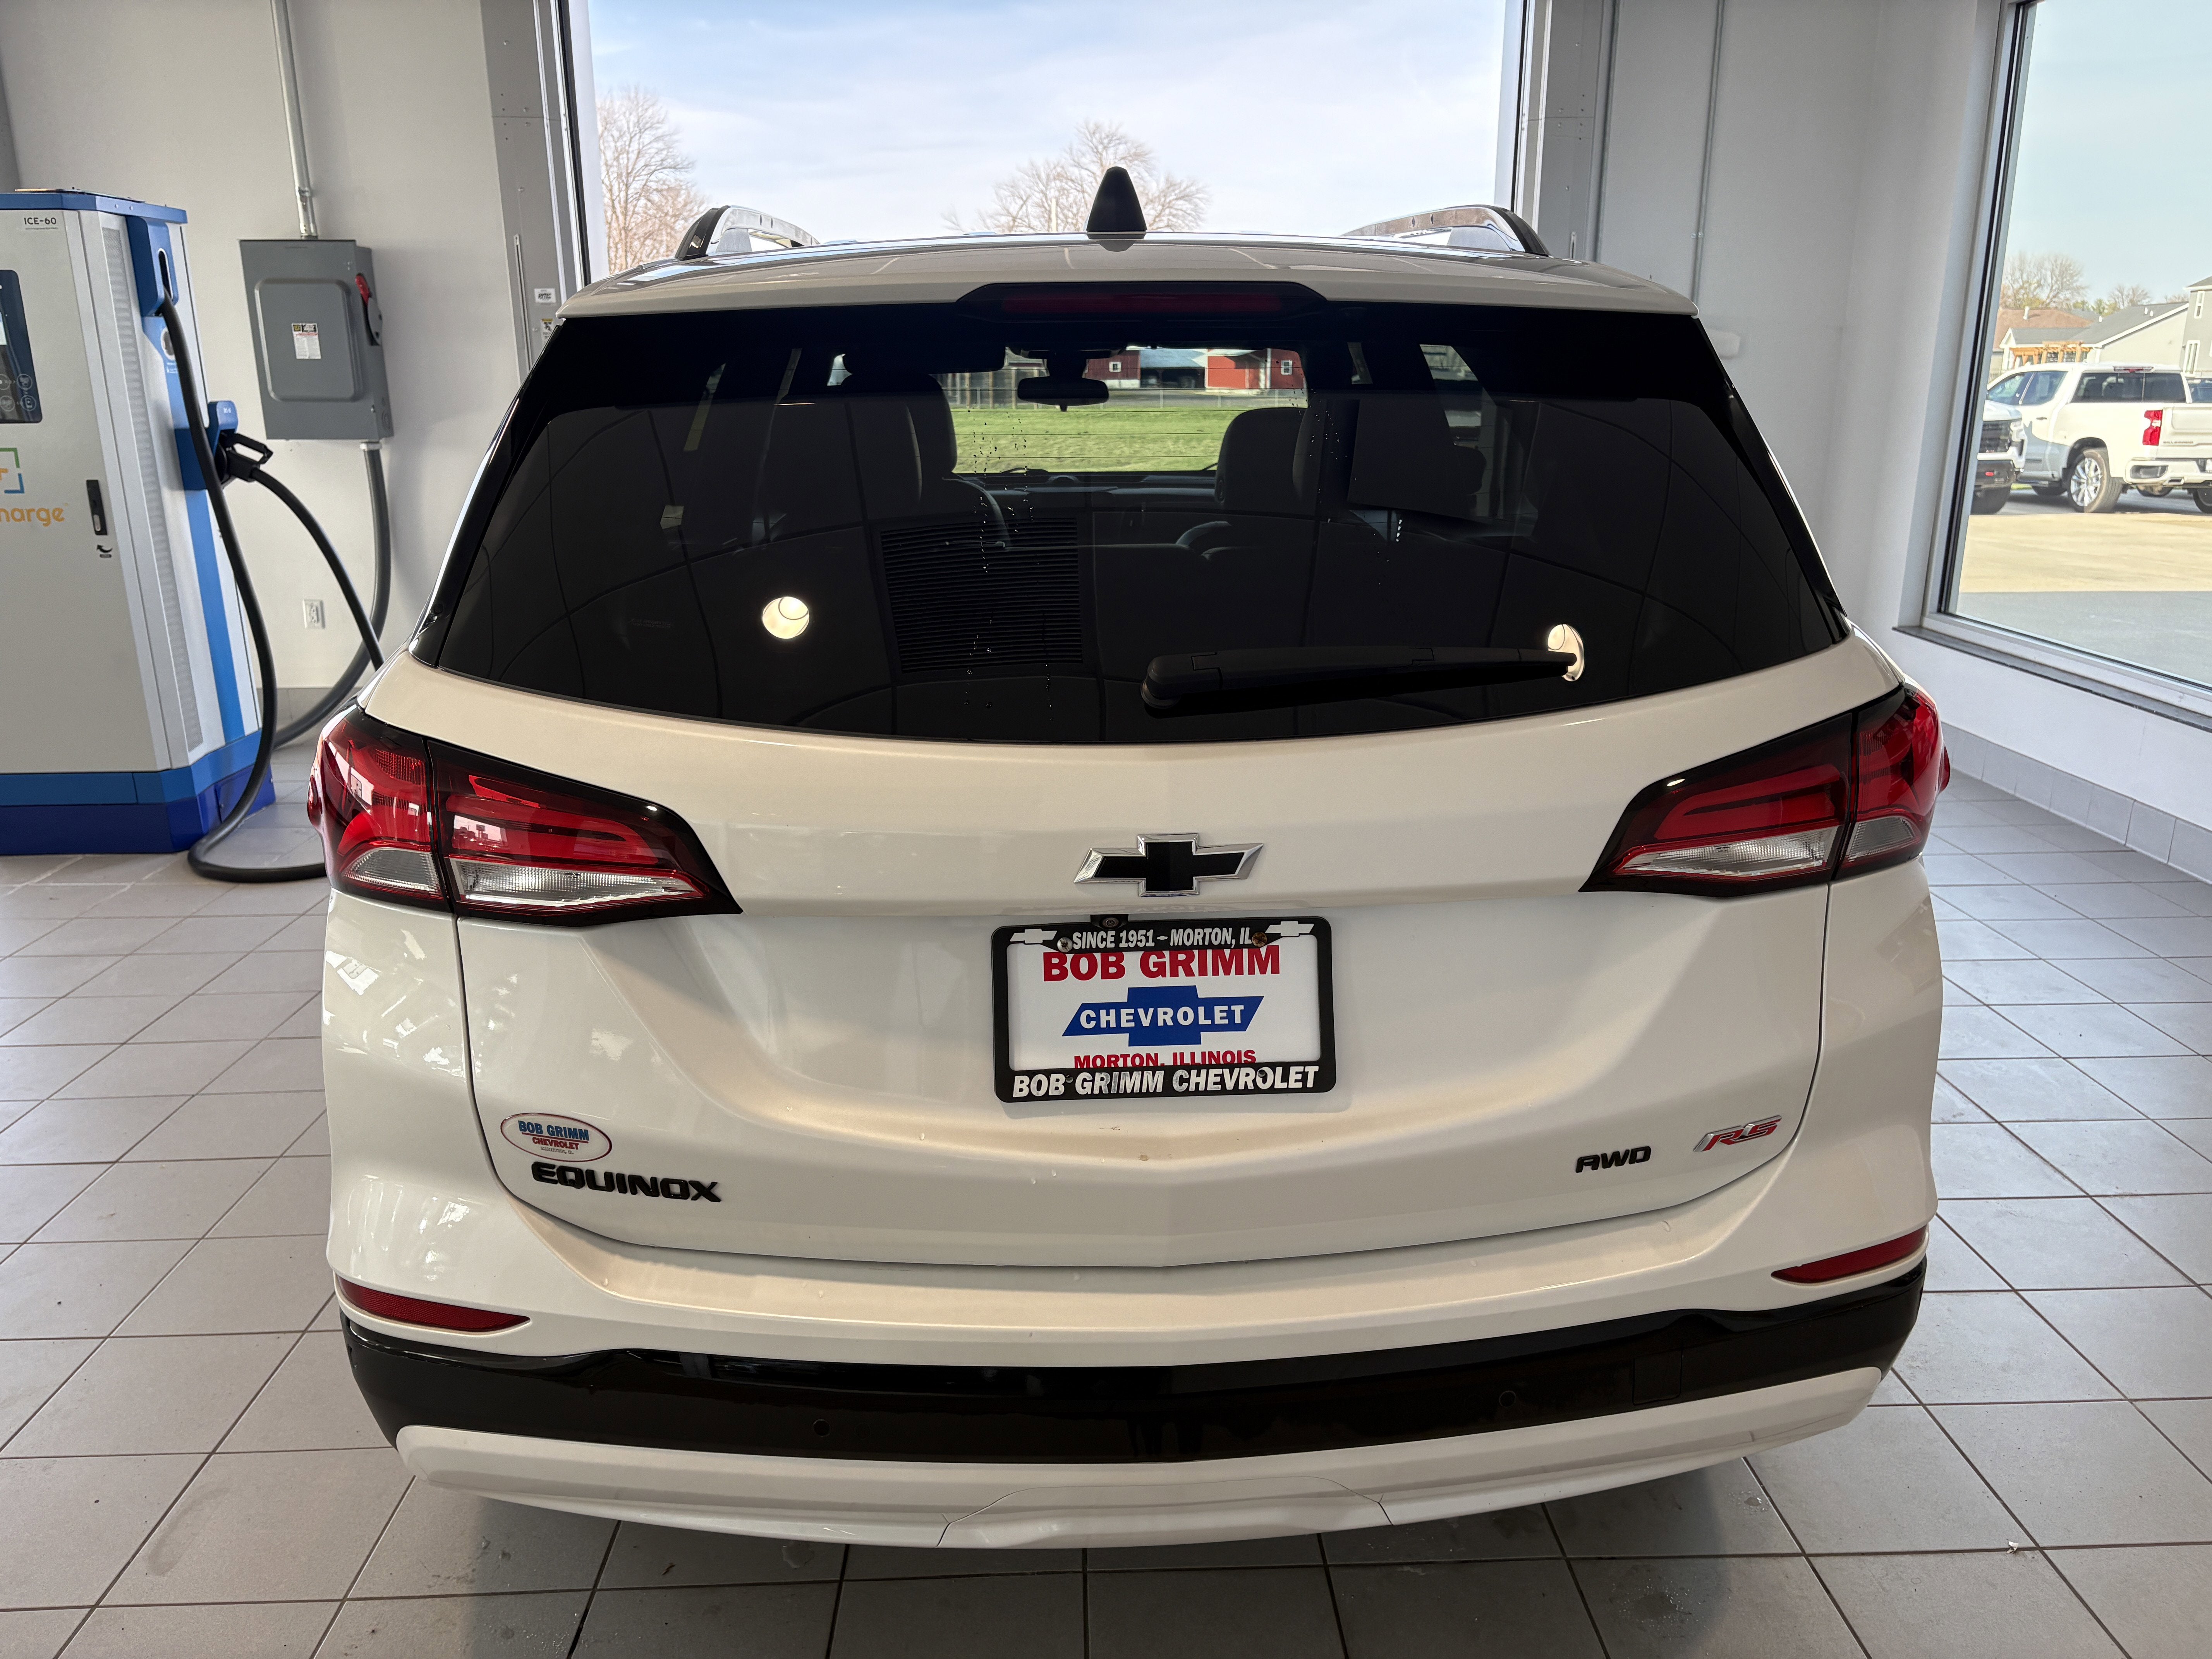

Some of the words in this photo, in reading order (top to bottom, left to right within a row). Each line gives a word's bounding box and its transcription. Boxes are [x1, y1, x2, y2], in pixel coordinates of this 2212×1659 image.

[1072, 931, 1116, 949] SINCE
[1119, 929, 1155, 947] 1951
[1170, 927, 1236, 948] MORTON,
[1239, 927, 1252, 945] IL
[1043, 951, 1126, 981] BOB
[1139, 945, 1280, 978] GRIMM
[1080, 1005, 1244, 1029] CHEVROLET
[1173, 1049, 1256, 1066] ILLINOIS
[1013, 1073, 1066, 1097] BOB
[1075, 1070, 1164, 1095] GRIMM
[1173, 1065, 1319, 1092] CHEVROLET
[518, 1120, 543, 1134] BOB
[546, 1125, 589, 1141] GRIMM
[1693, 1115, 1782, 1152] RS
[532, 1137, 579, 1150] CHEVROLET
[1575, 1146, 1652, 1173] AWD
[531, 1161, 722, 1202] EQUINOX
